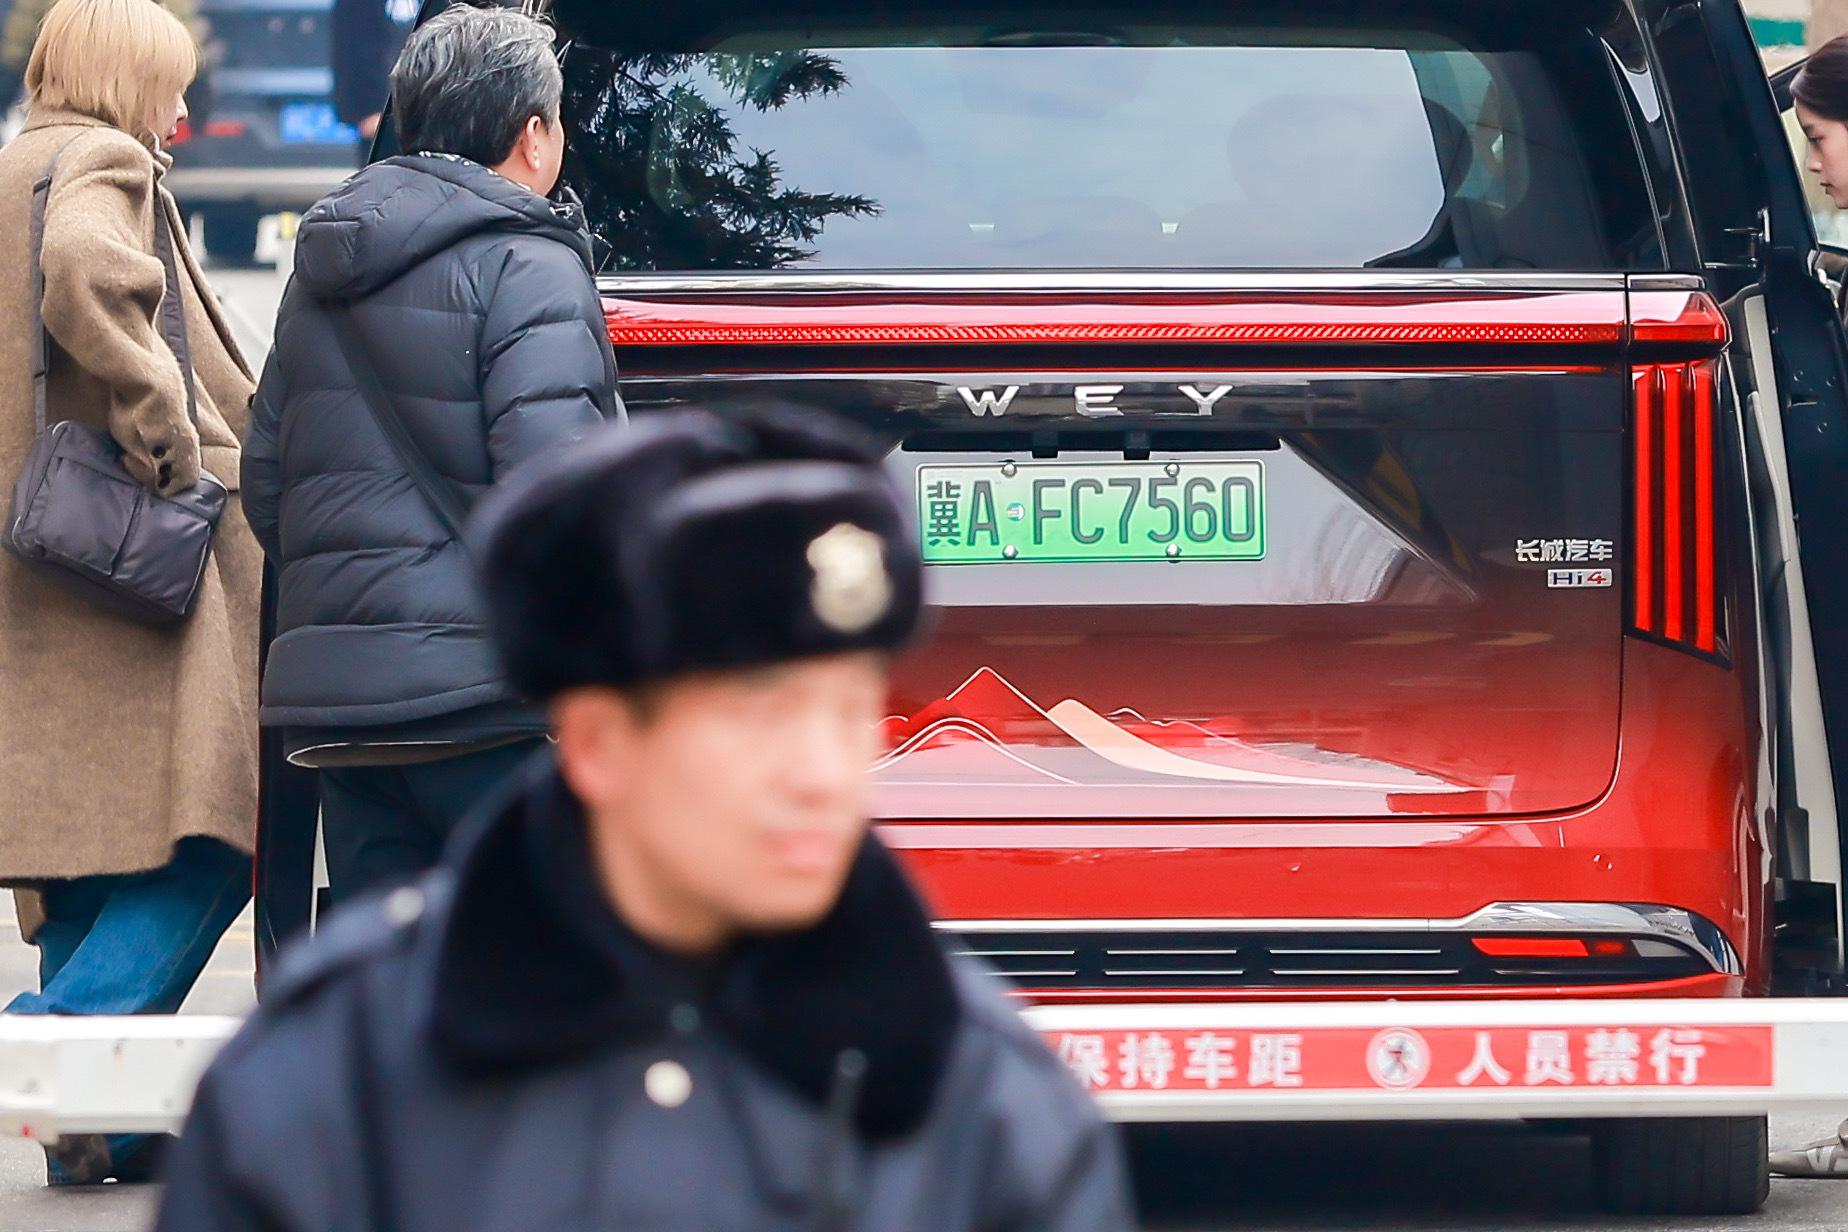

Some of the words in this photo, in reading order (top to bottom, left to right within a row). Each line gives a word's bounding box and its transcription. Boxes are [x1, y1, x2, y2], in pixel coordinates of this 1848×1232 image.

[957, 385, 1233, 417] WEY
[1515, 539, 1613, 562] 长城汽车
[1552, 571, 1607, 585] Hi4
[1057, 1032, 1303, 1089] 保持车距
[1456, 1028, 1706, 1086] 人员禁行
